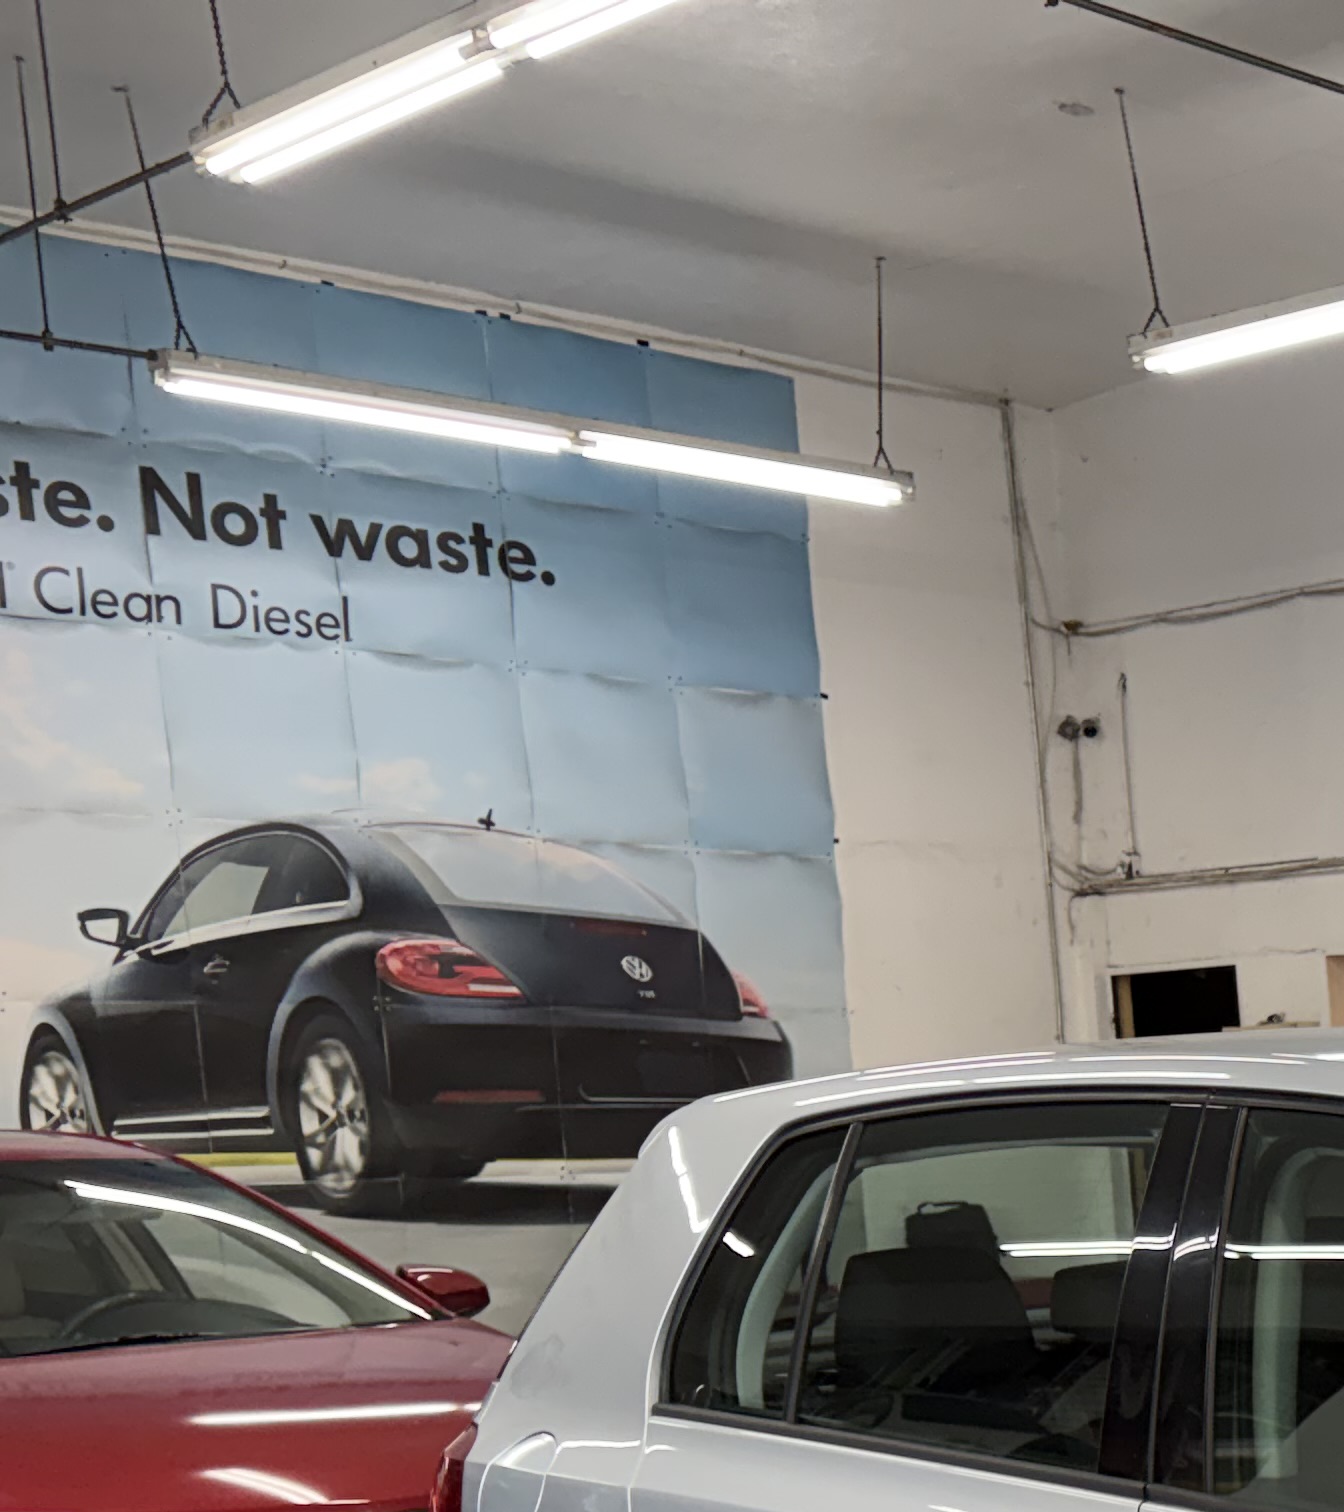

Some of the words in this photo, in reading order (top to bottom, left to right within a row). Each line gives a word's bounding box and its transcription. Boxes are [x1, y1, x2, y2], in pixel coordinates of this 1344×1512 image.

[138, 465, 287, 550] Not
[311, 513, 557, 586] waste.
[34, 565, 183, 625] Clean
[210, 582, 353, 643] Diesel
